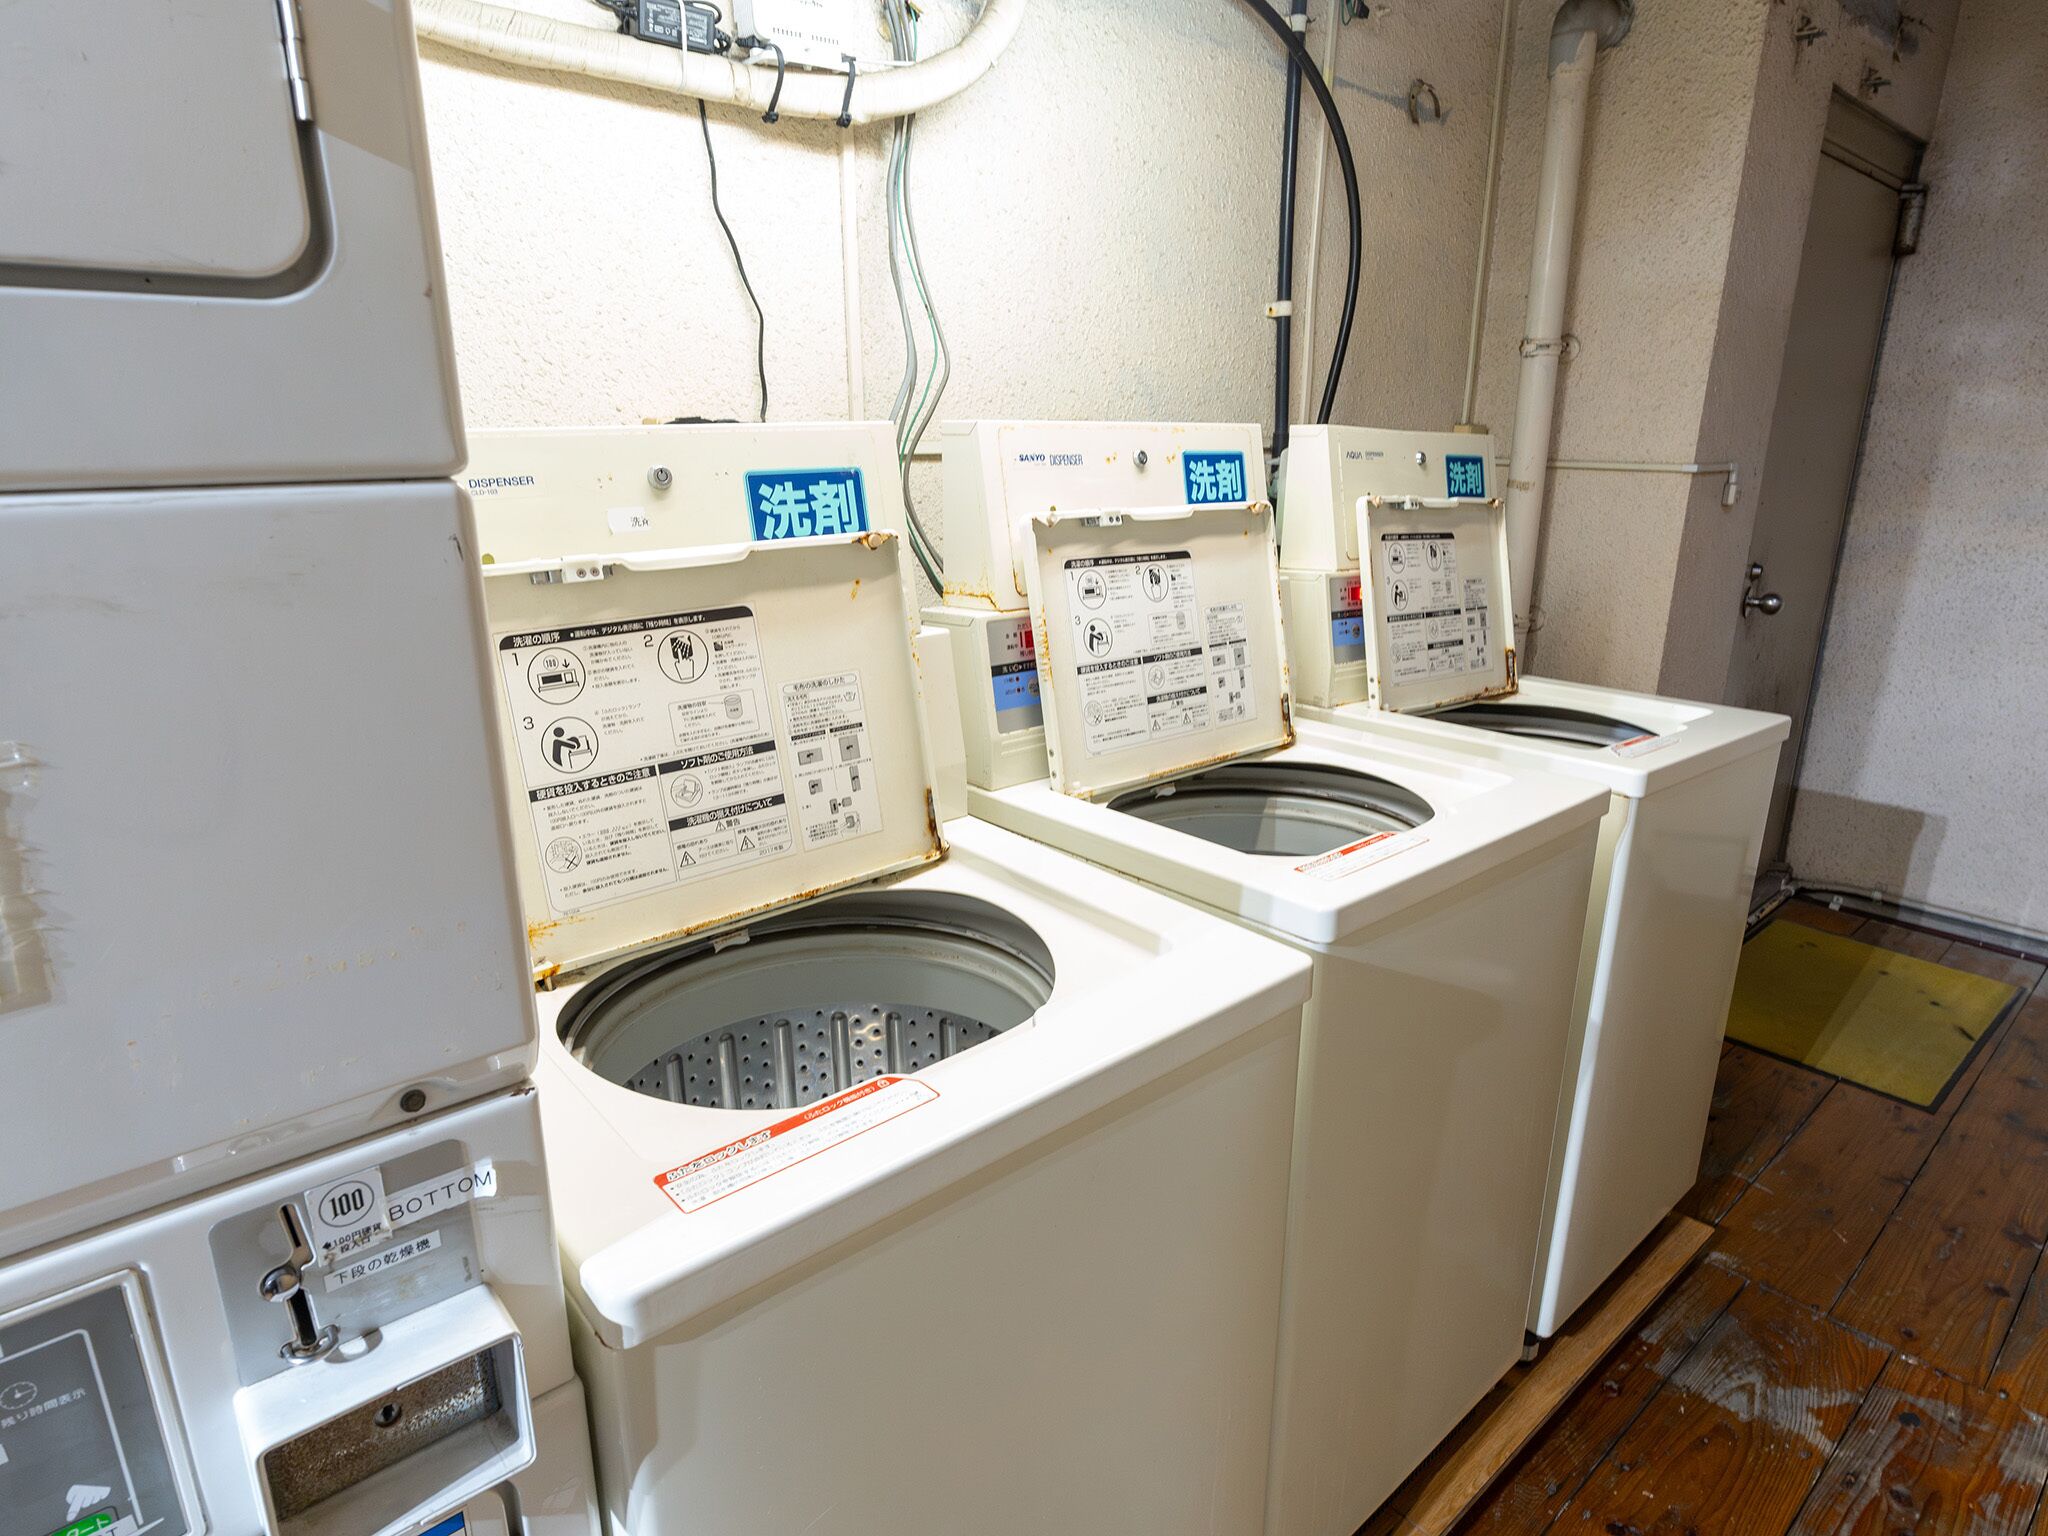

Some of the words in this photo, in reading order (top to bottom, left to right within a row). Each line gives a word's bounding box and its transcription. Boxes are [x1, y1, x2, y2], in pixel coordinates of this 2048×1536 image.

[1019, 454, 1046, 462] SANYO
[1050, 454, 1083, 466] DISPENSER
[1346, 451, 1363, 459] AQUA
[469, 476, 534, 489] DISPENSER
[1188, 459, 1242, 501] 洗剤
[1449, 462, 1482, 494] 洗剤
[758, 479, 859, 541] 洗剤
[1135, 565, 1141, 575] 2
[1075, 615, 1081, 626] 3
[513, 631, 561, 648] 洗濯の順序
[643, 634, 655, 648] 2
[511, 652, 520, 666] 1
[523, 716, 535, 730] 3
[680, 746, 754, 770] ソフト剤のご使用方法
[536, 767, 651, 800] 硬貨を投入するときのご注意
[667, 1129, 771, 1181] ふたをロックします
[328, 1188, 365, 1221] 100
[389, 1171, 492, 1222] BOTTOM
[334, 1238, 432, 1285] 下段の乾燥機
[1, 1387, 87, 1429] 残り時間表示
